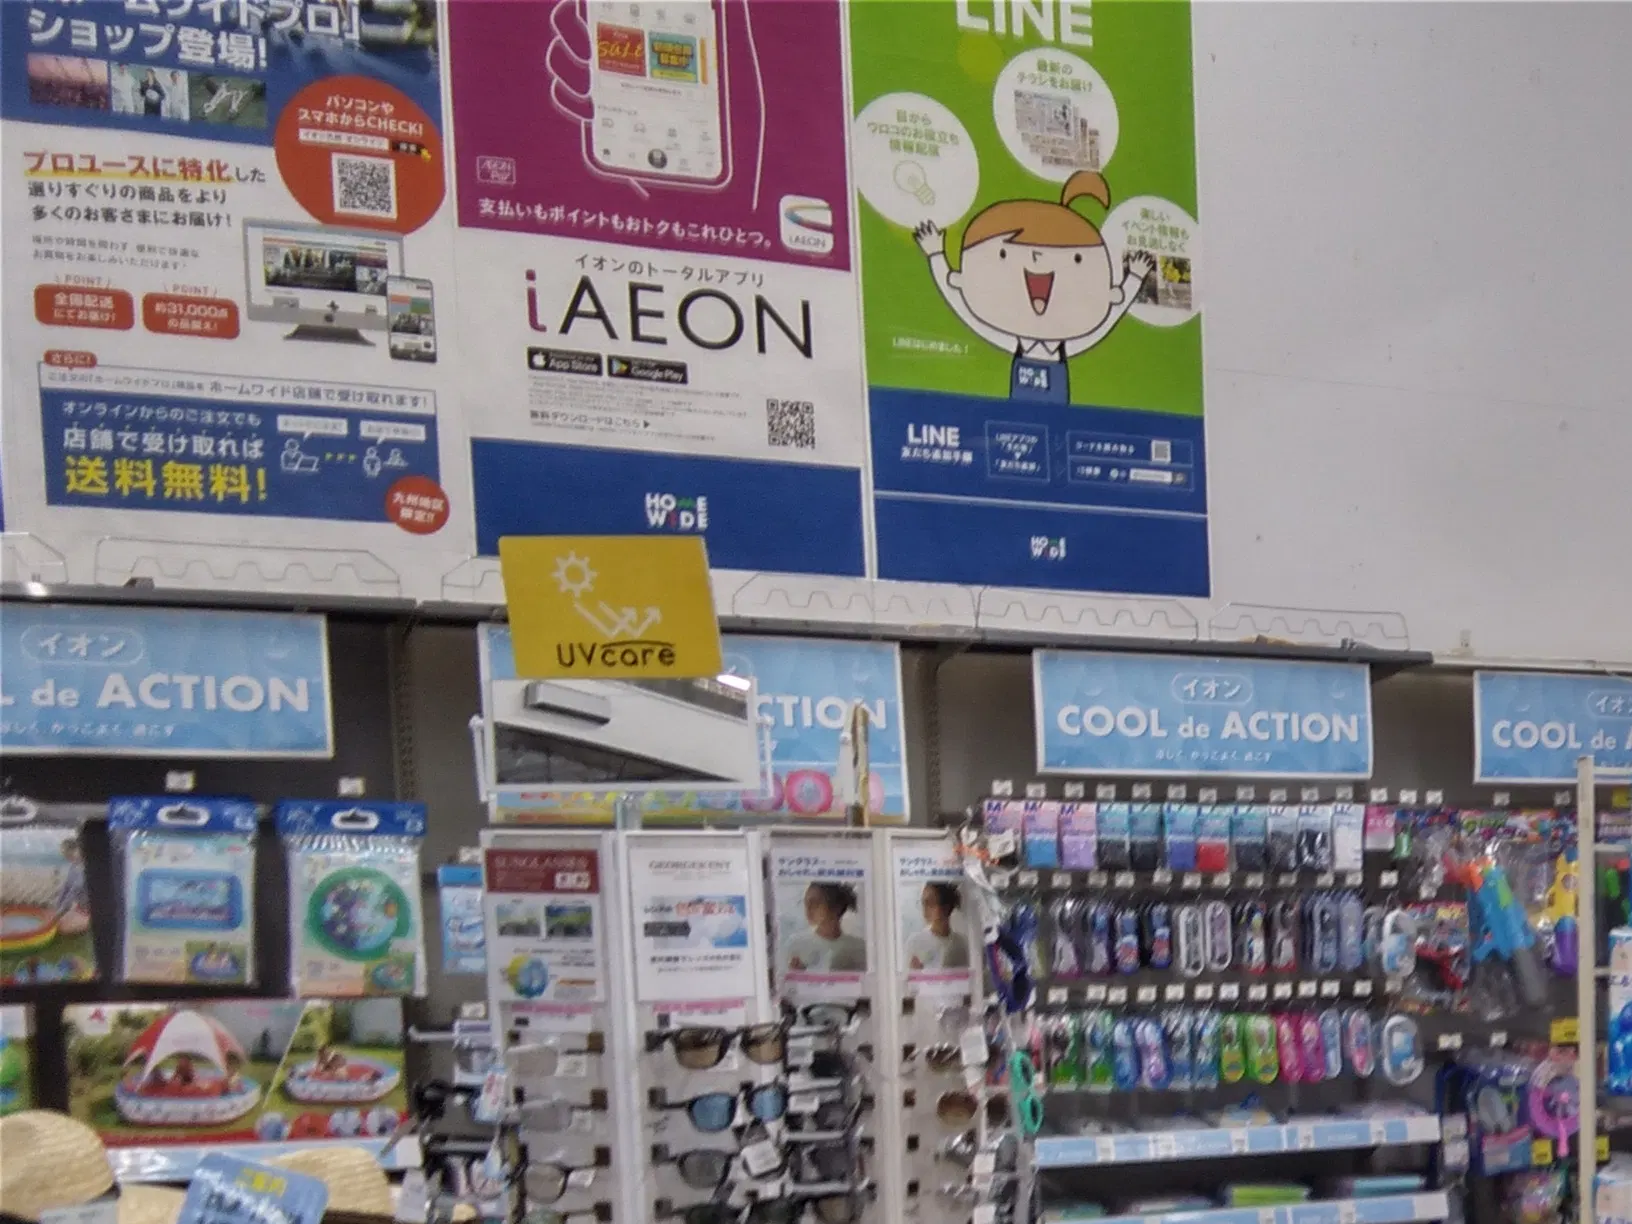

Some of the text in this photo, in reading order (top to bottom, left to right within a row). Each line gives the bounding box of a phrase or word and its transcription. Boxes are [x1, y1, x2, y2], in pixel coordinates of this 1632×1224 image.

[28, 9, 268, 70] ショップ登場!
[326, 93, 395, 115] パソコンや
[298, 107, 424, 136] スマホからCHECK!
[28, 180, 227, 206] 選りすぐりの商品をより
[477, 197, 773, 249] 支払いもポイントもおトクもこれひとつ。
[574, 253, 765, 288] イオンのトータルアプリ
[525, 268, 815, 360] iAEON
[61, 401, 263, 428] オンラインからのご注文でも
[63, 426, 264, 460] 店舗で受け取れば
[907, 423, 961, 448] LINE
[65, 456, 269, 504] 送料無料!
[37, 630, 128, 658] イオン
[30, 672, 310, 713] de ACTION
[1183, 676, 1242, 700] イオン
[754, 693, 888, 730] CTION
[1057, 704, 1360, 743] COOL de ACTION
[1492, 718, 1583, 749] COOL
[1590, 728, 1617, 751] de
